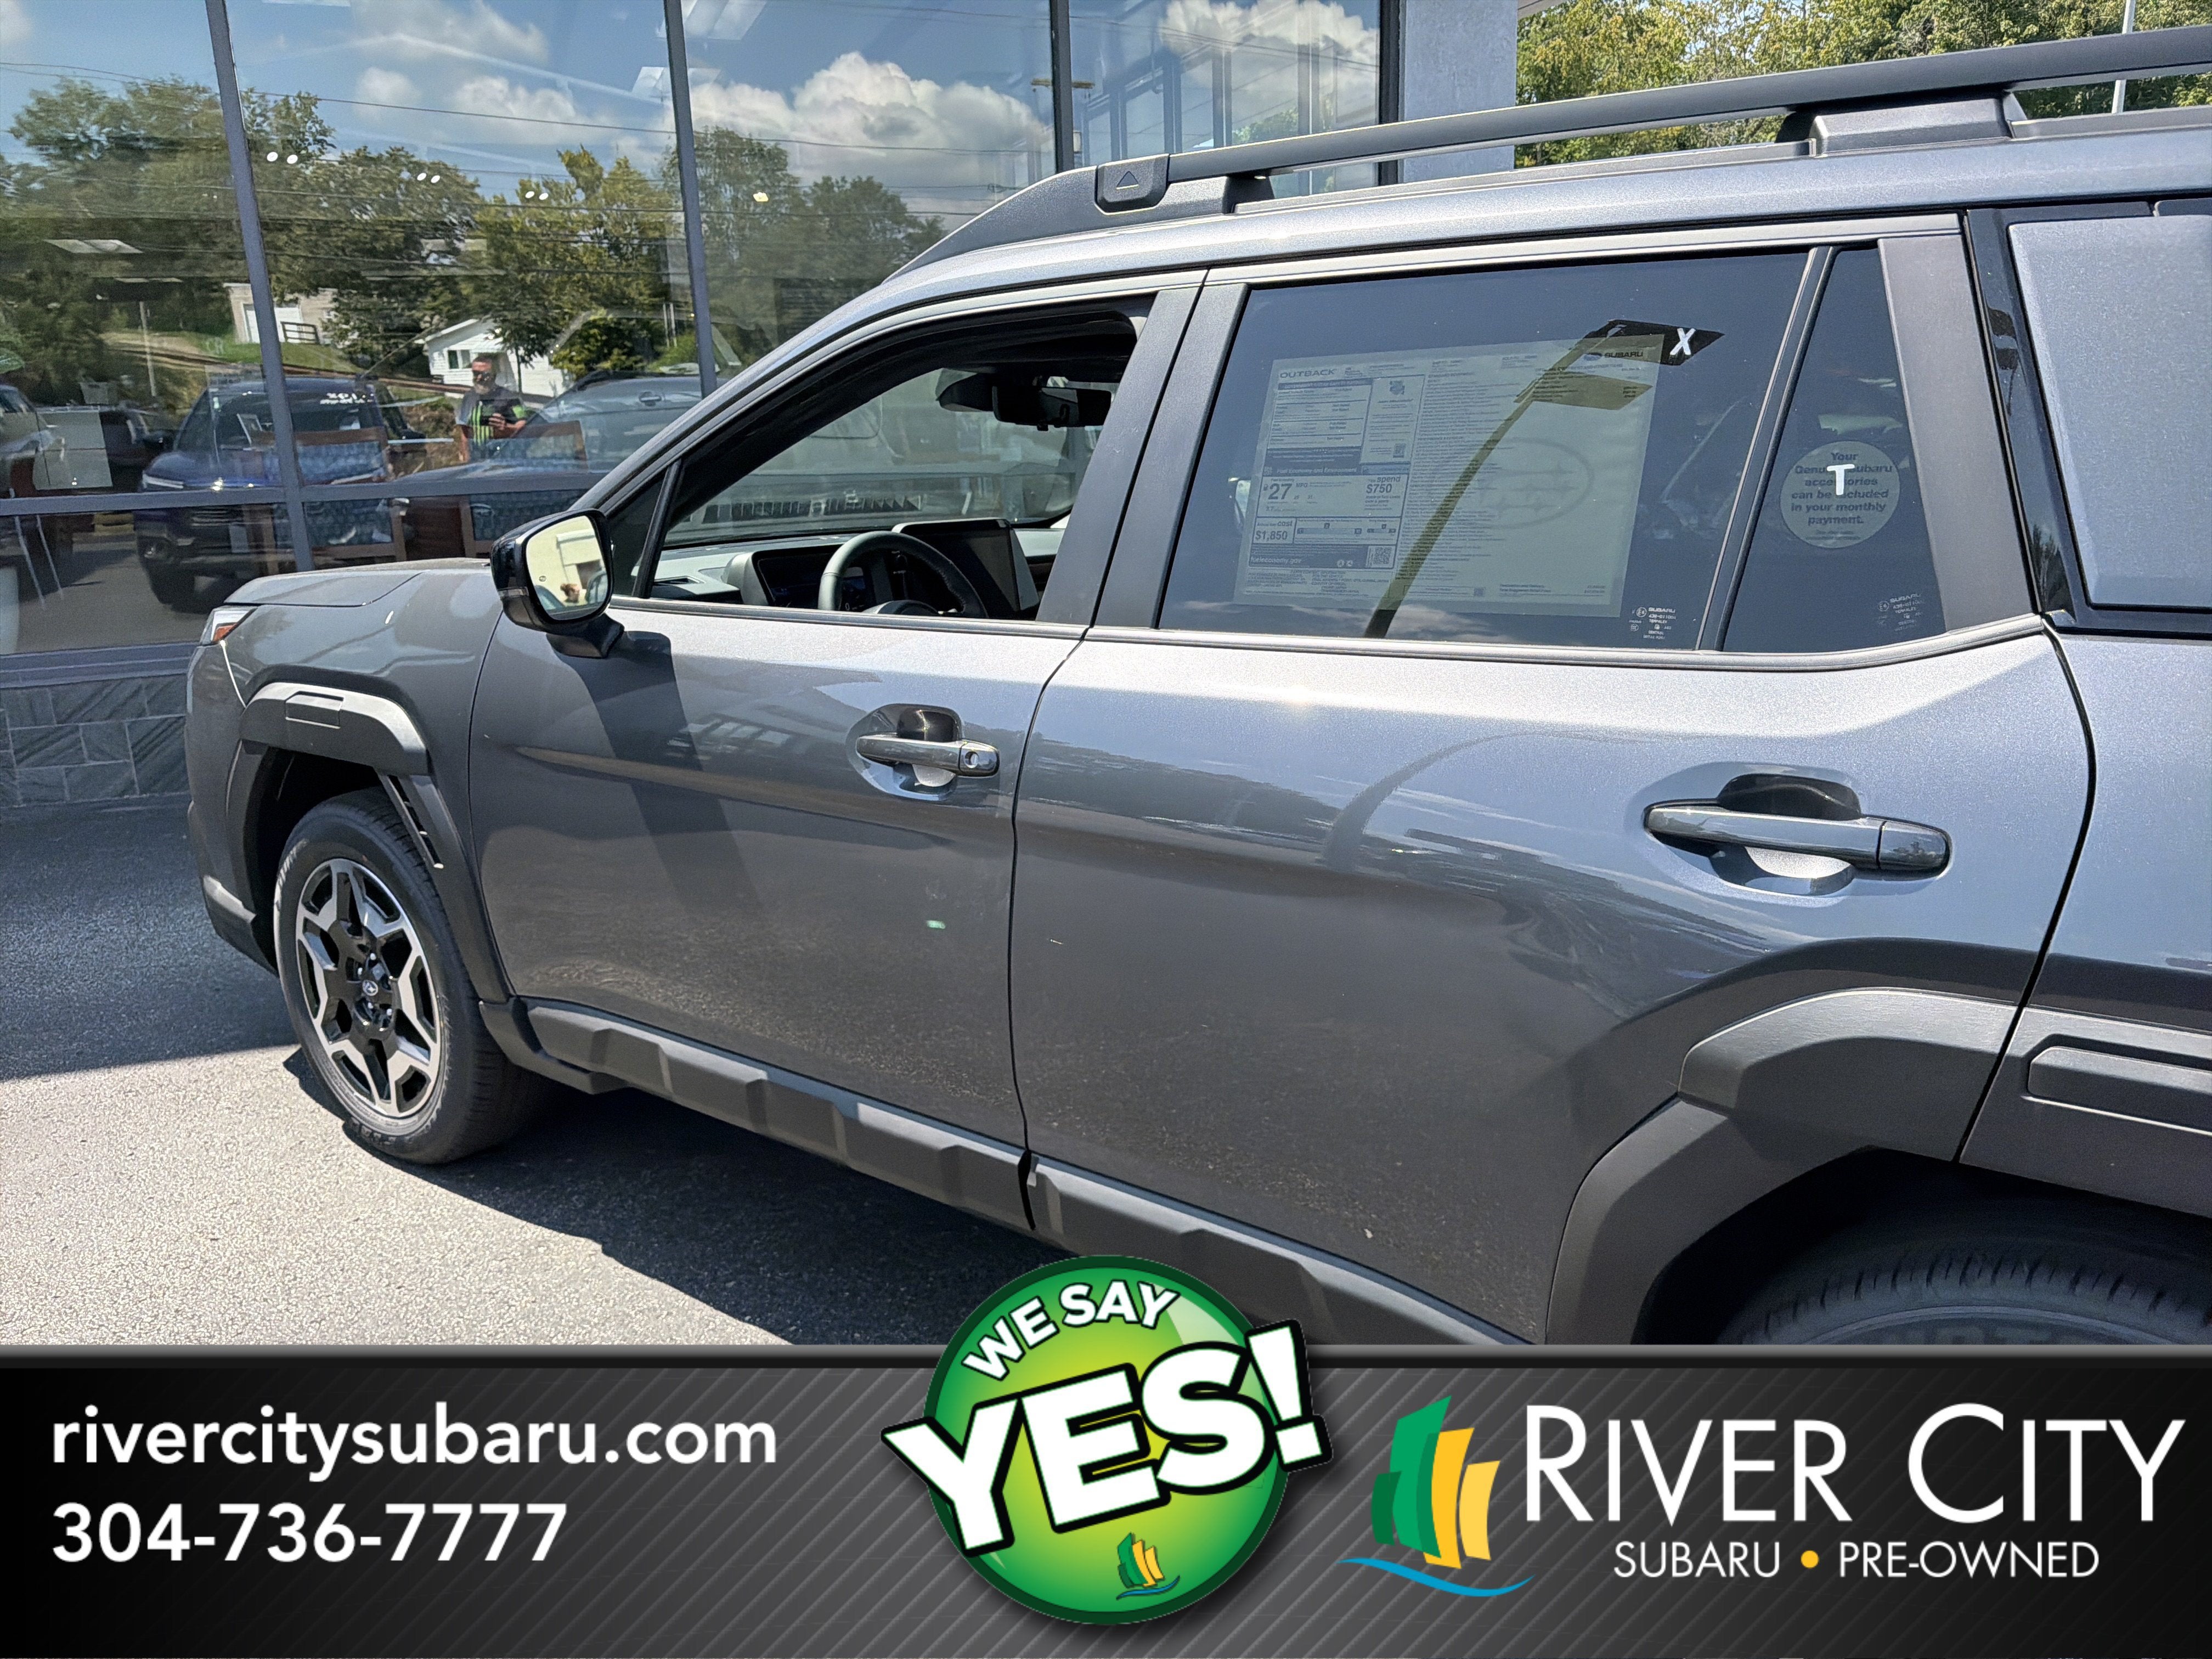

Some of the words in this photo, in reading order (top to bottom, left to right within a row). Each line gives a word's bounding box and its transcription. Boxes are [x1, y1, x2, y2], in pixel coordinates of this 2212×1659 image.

[1670, 328, 1695, 356] X
[1280, 369, 1335, 378] OUTBACK
[1831, 453, 1858, 461] Your
[1795, 465, 1844, 474] Genu
[1805, 477, 1878, 487] acceories
[1826, 464, 1855, 495] T
[1268, 483, 1292, 500] 27
[1366, 483, 1392, 493] $750
[1816, 490, 1831, 498] be
[1835, 489, 1889, 498] cluded
[1791, 503, 1802, 511] in
[1806, 505, 1831, 513] your
[1836, 502, 1886, 512] monthly
[1808, 515, 1864, 526] payment.
[1255, 530, 1288, 541] $1,850
[1251, 556, 1302, 564] fueleconomy.gov
